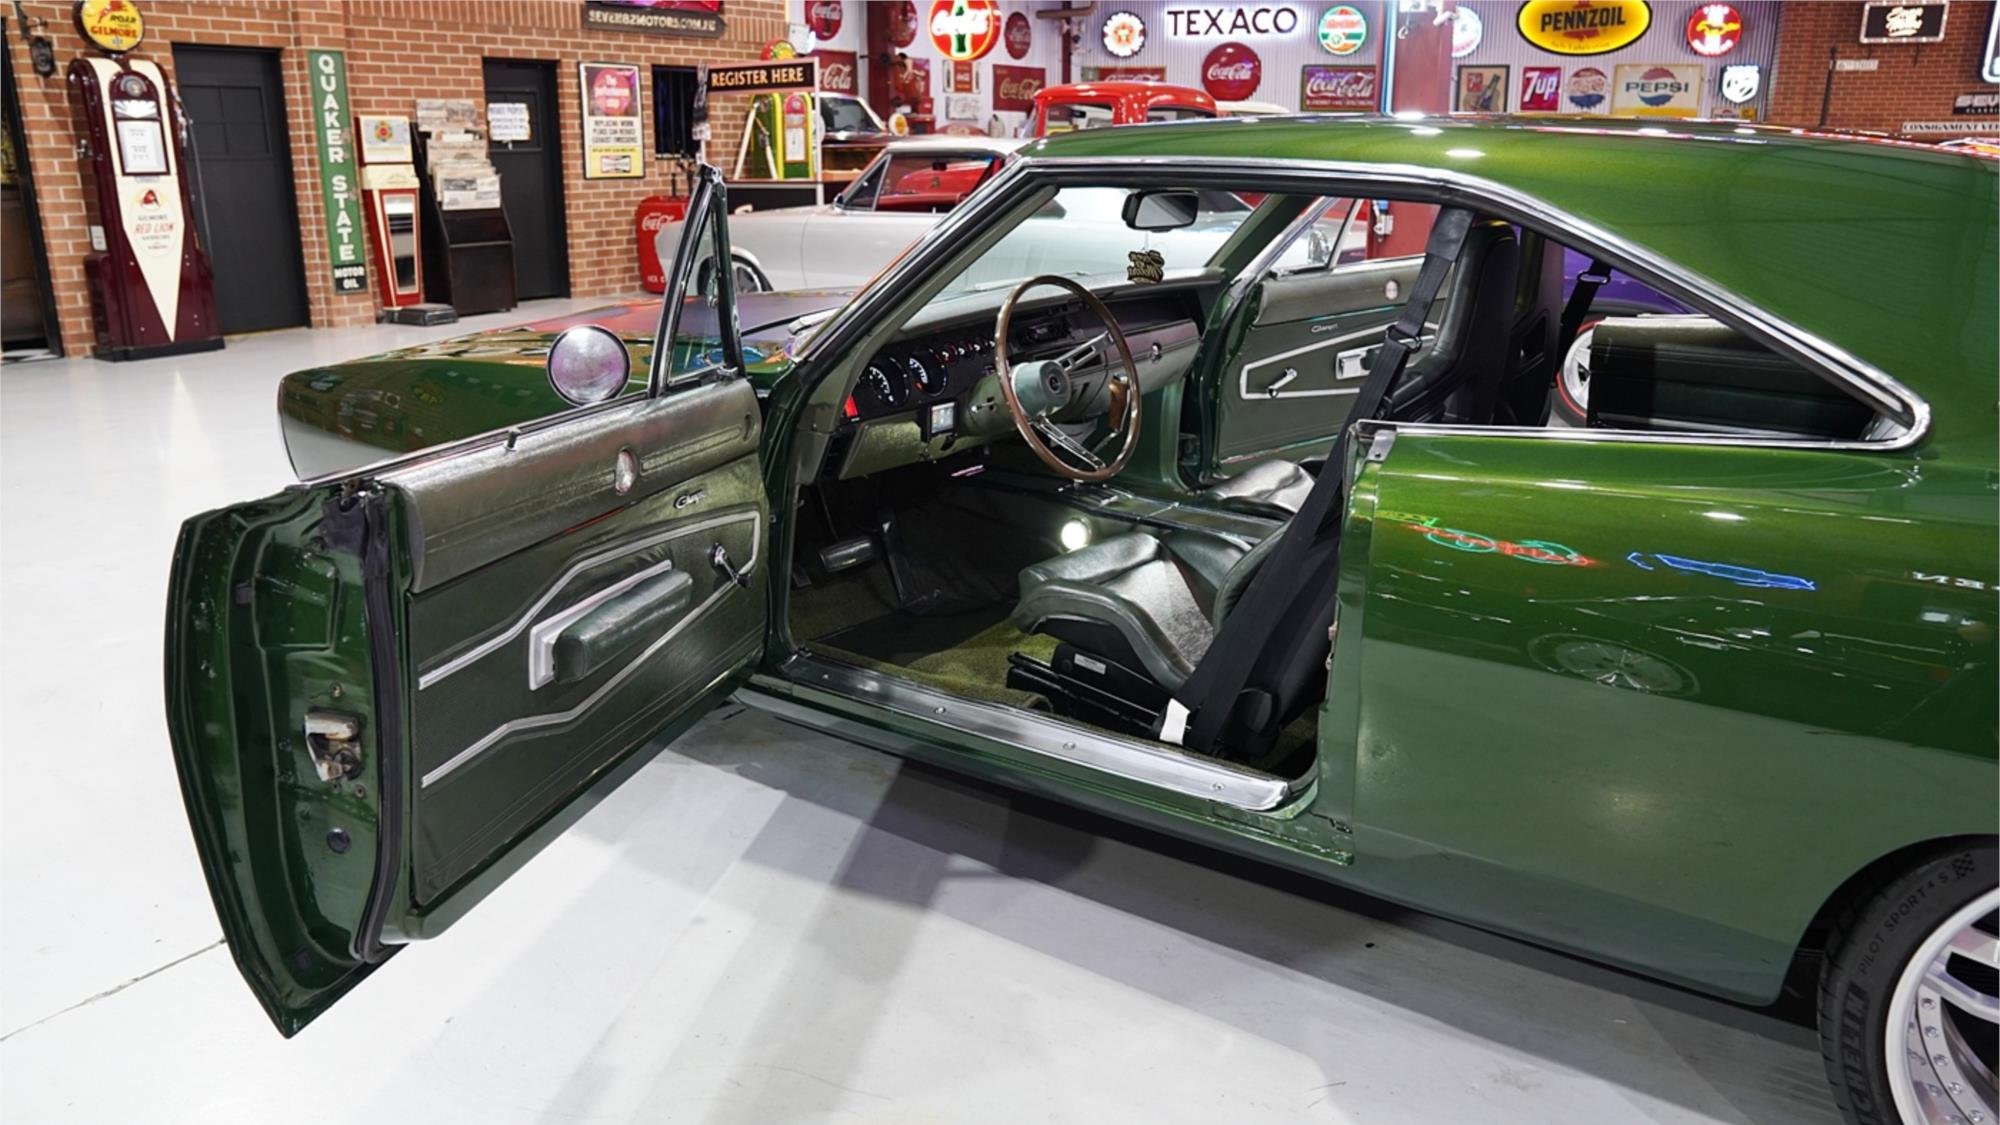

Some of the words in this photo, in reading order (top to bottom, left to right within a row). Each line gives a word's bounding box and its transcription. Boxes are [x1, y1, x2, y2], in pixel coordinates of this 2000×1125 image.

[1167, 8, 1297, 36] TEXACO
[1541, 6, 1627, 32] PENNZOIL
[711, 69, 768, 87] REGISTER
[771, 67, 804, 83] HERE
[1625, 82, 1689, 92] PEPSI
[318, 54, 345, 164] QUAKER
[331, 174, 356, 262] STATE
[334, 265, 364, 280] MOTOR
[343, 277, 360, 290] OIL
[1857, 932, 1886, 975] PILOT
[1884, 885, 1928, 932] SPORT
[1938, 871, 1949, 883] S
[1841, 979, 1880, 1125] ICHELIN
